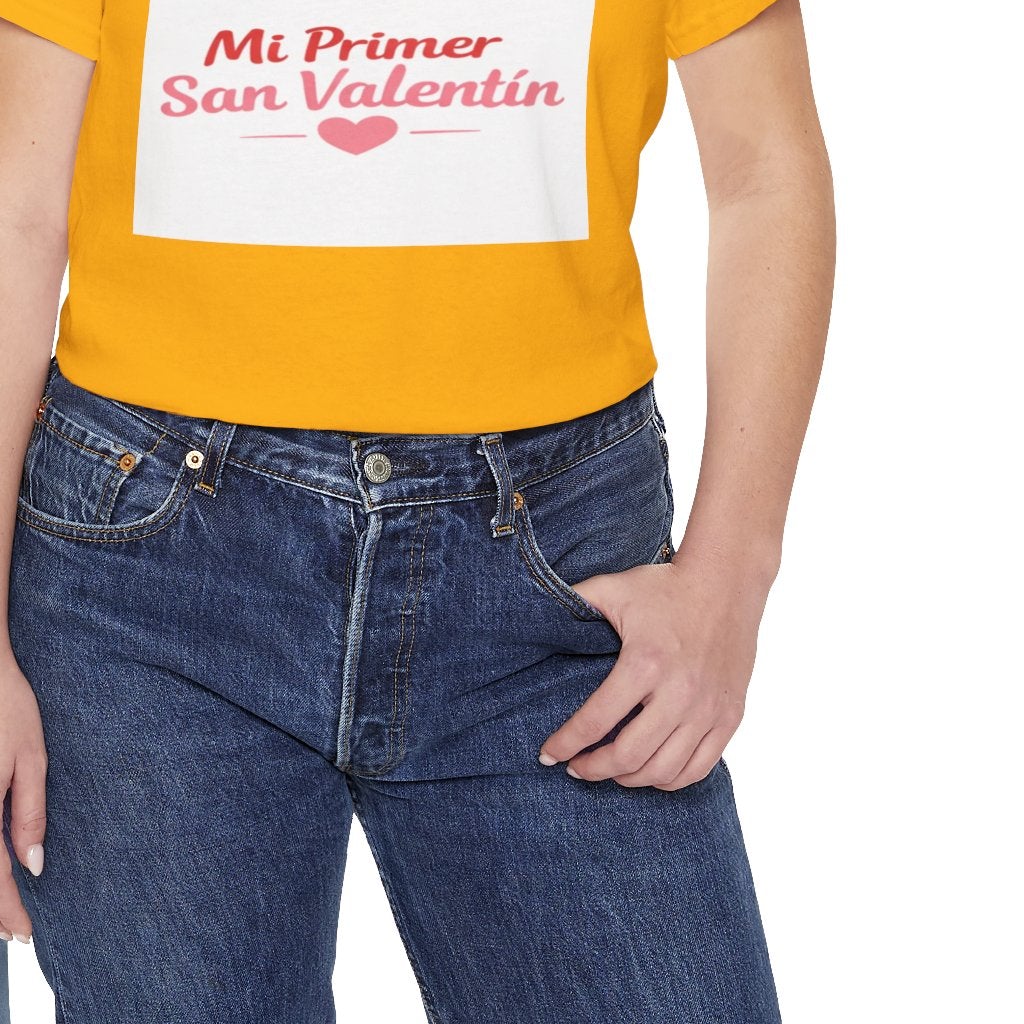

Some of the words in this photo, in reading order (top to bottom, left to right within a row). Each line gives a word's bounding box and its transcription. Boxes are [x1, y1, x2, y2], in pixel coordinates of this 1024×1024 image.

[203, 27, 289, 68] Mi
[303, 25, 503, 63] Primer
[160, 74, 288, 118] San
[299, 63, 565, 111] Valentín
